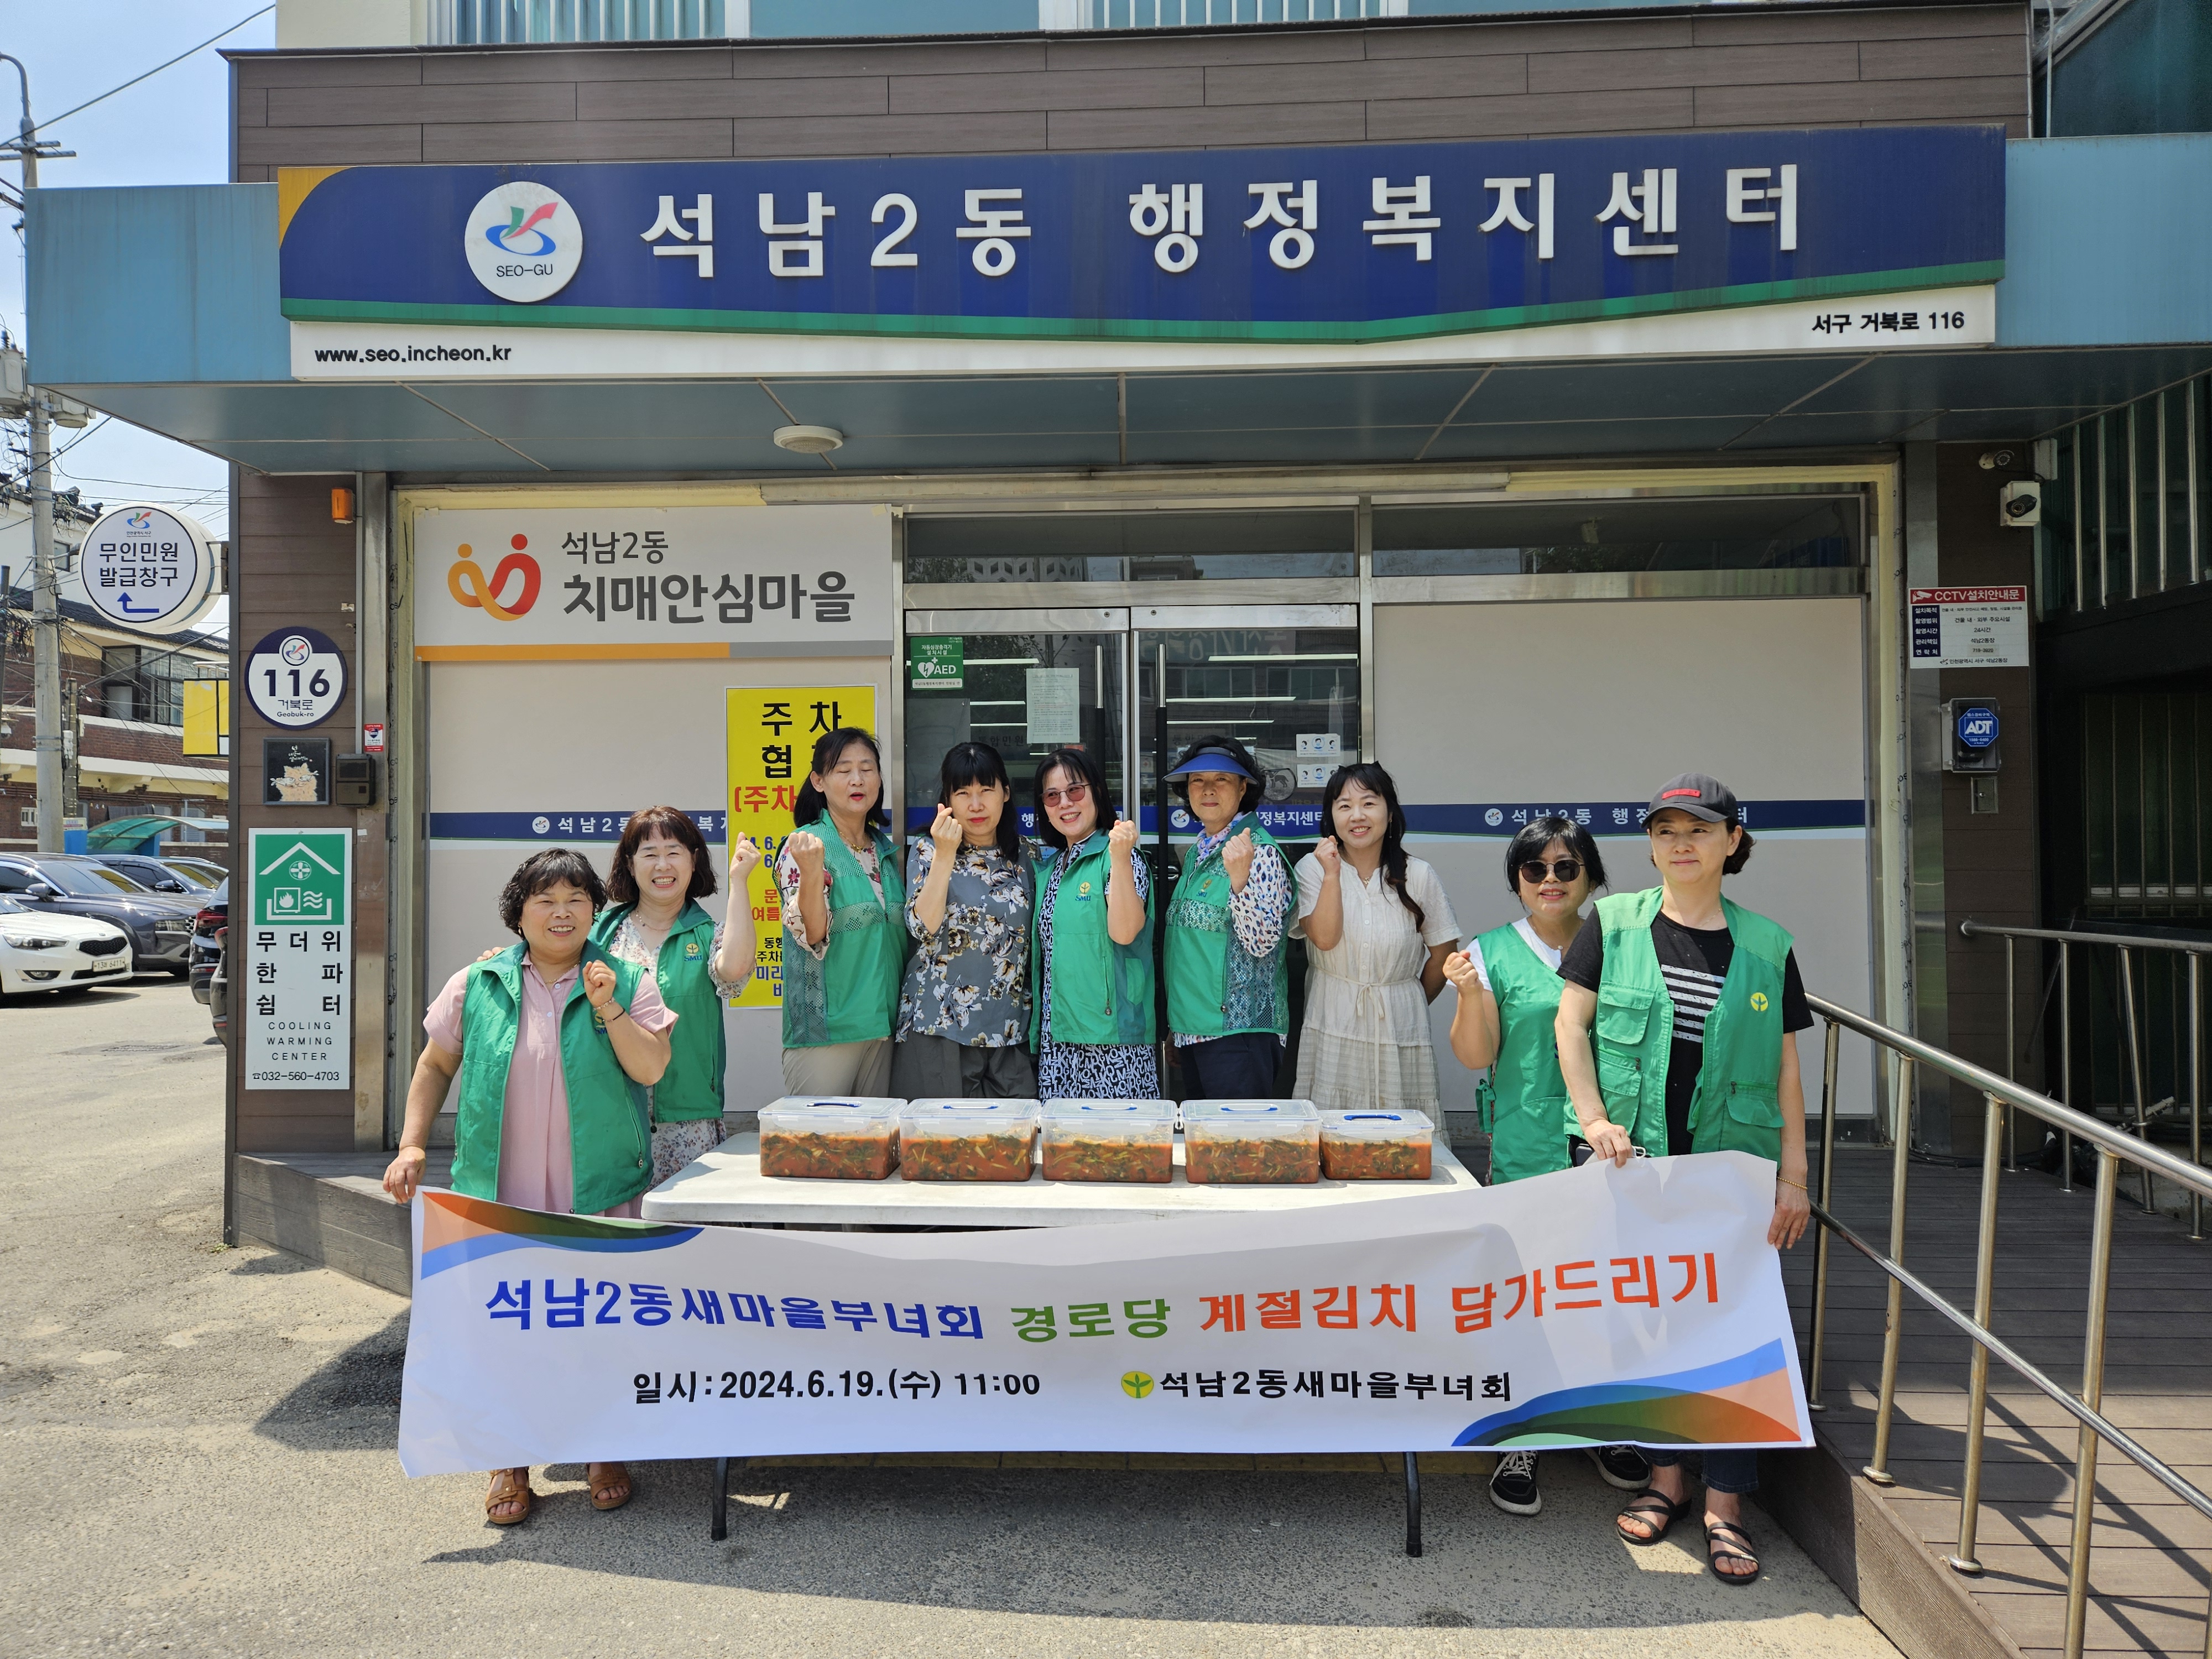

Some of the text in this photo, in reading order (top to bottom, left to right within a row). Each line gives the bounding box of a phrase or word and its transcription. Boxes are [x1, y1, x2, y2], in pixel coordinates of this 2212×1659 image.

[640, 164, 1797, 278] 석남2동 행정복지센터
[496, 263, 553, 277] SEO-GU
[1812, 310, 1965, 334] 서구 거북로 116
[314, 344, 512, 364] www.seo.incheon.kr
[100, 542, 178, 562] 무인민원
[561, 531, 669, 564] 석남2동
[100, 567, 178, 587] 발급창구
[564, 571, 855, 624] 치매안심마을
[1934, 589, 2020, 601] CCTV설치안내문
[933, 665, 957, 675] AED
[263, 669, 330, 697] 116
[278, 700, 313, 710] 거북로
[1965, 721, 1993, 734] ADT
[256, 931, 341, 952] 무더위
[256, 962, 343, 983] 한파
[256, 994, 341, 1015] 쉼터
[268, 1022, 332, 1030] COOLING
[267, 1037, 332, 1045] WARMING
[272, 1052, 327, 1061] CENTER
[262, 1071, 340, 1081] 032-560-4703
[484, 1251, 1719, 1343] 석남2동새마을부녀회 경로당 계절김치 담가드리기
[954, 1372, 1040, 1396] 11:00
[1160, 1369, 1513, 1403] 석남2동새마을부녀회
